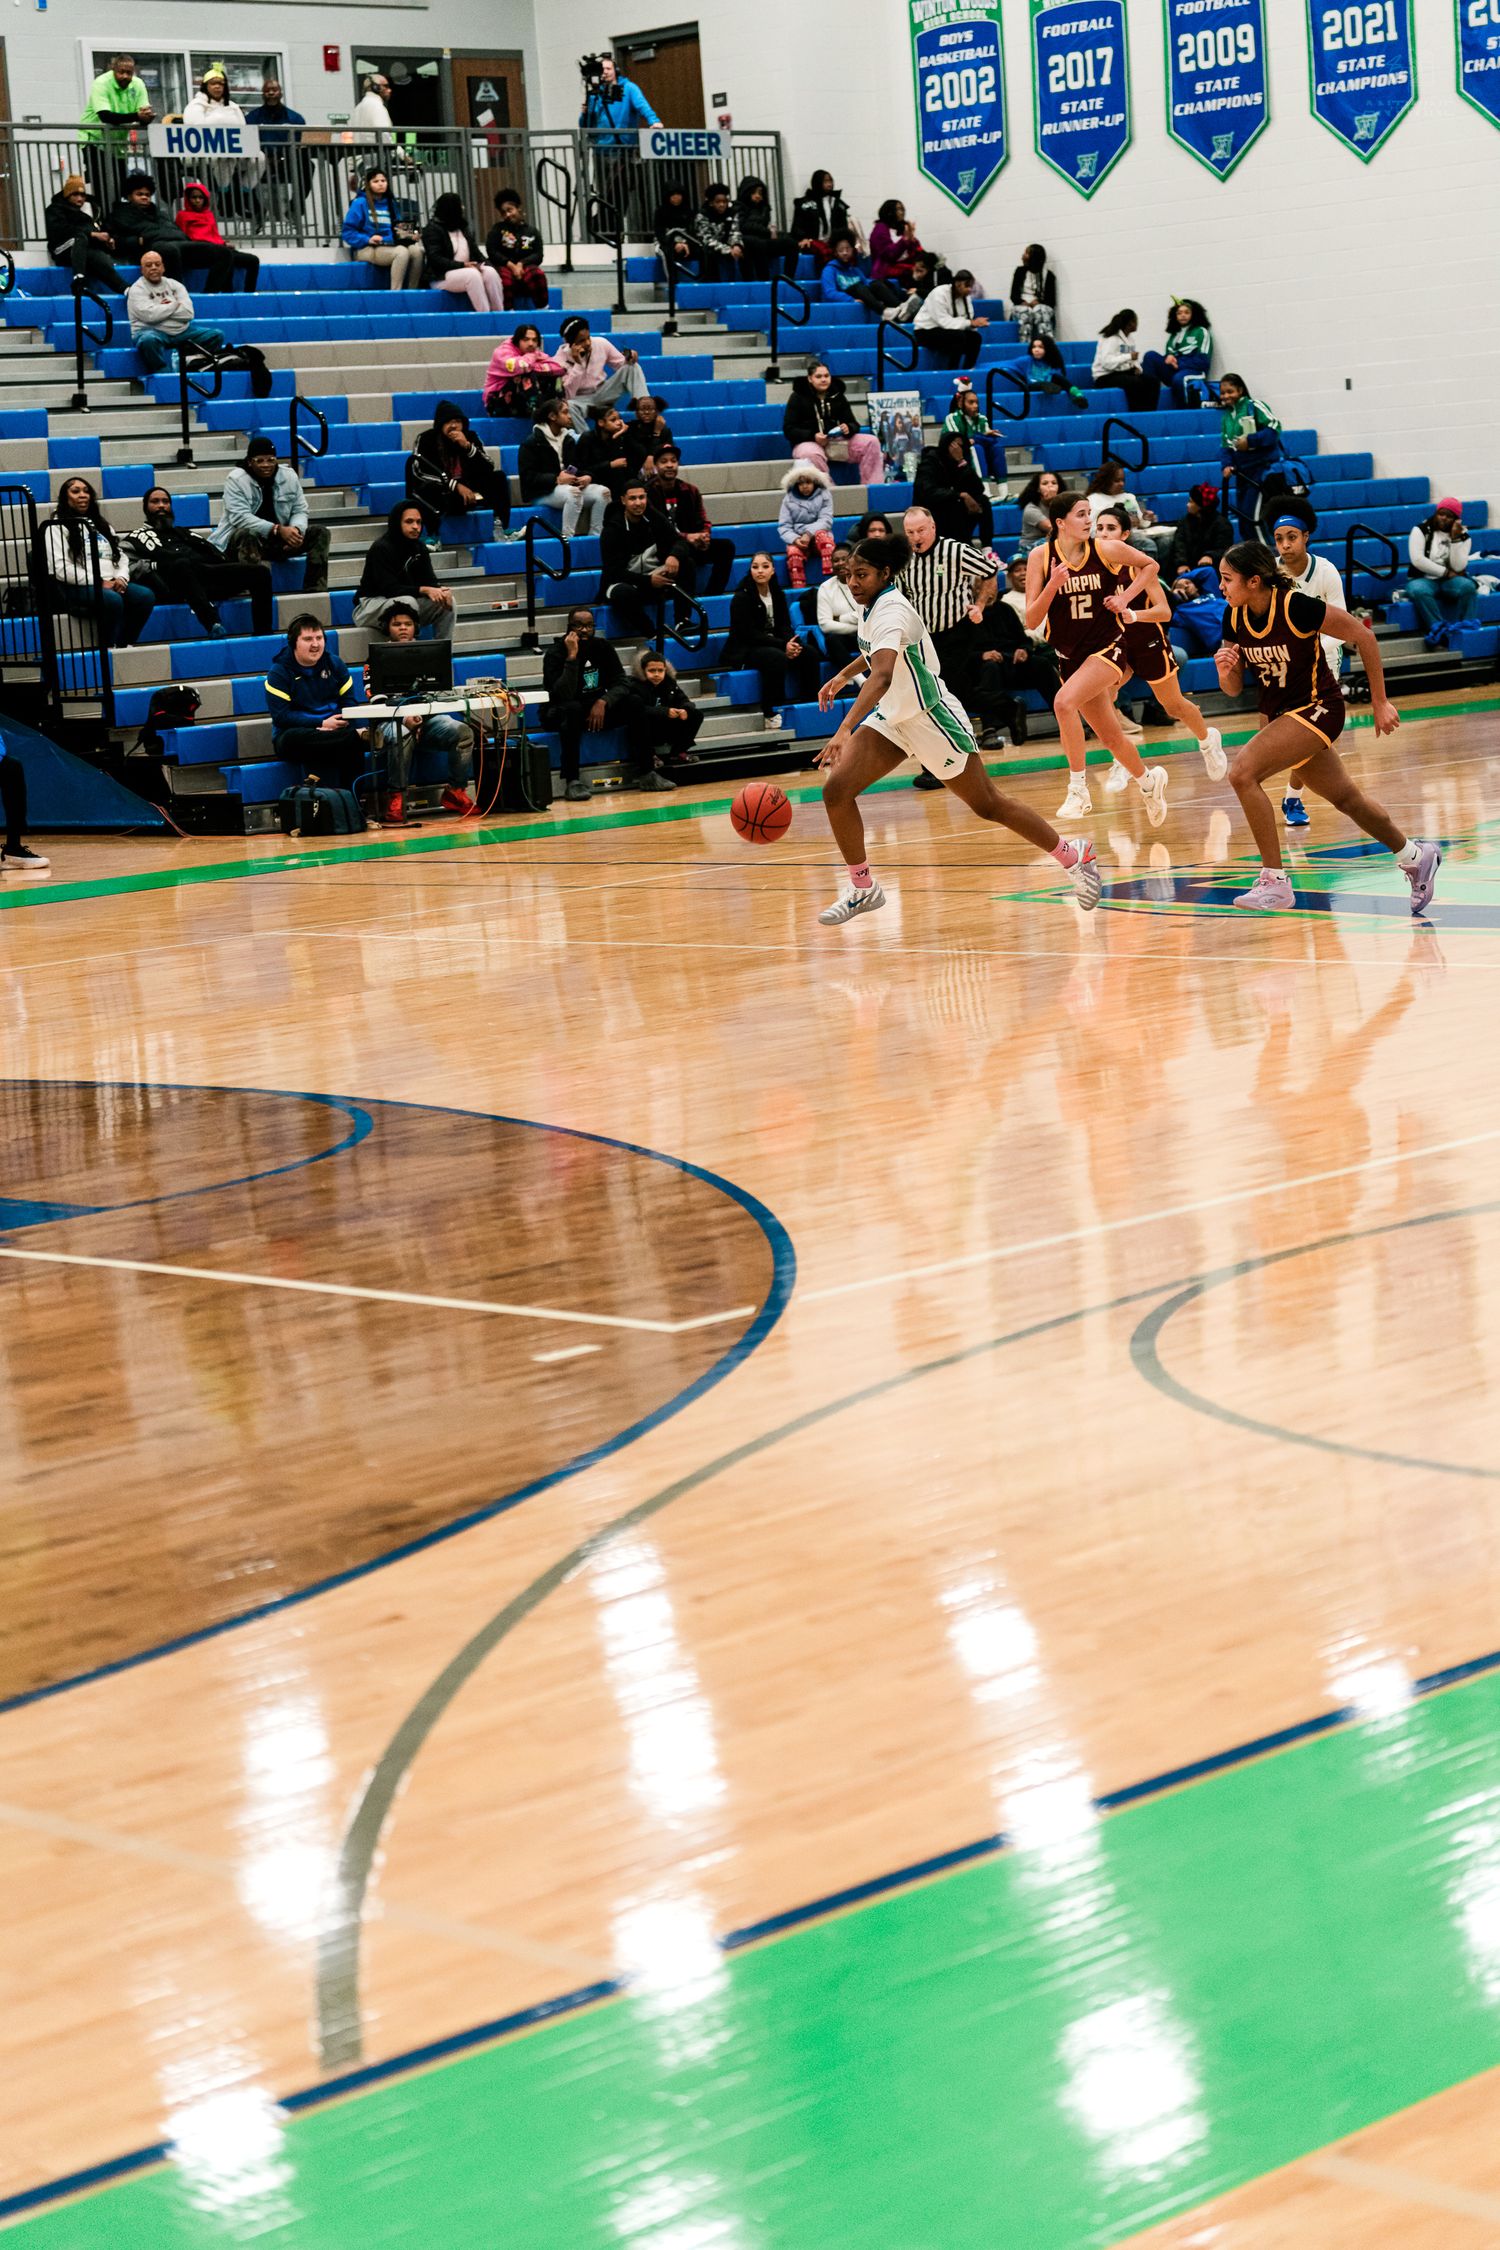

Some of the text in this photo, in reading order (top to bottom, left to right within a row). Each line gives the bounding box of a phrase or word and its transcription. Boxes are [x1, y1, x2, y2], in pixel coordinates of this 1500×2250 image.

[1042, 16, 1114, 38] FOOTBALL
[1322, 0, 1398, 51] 2021
[939, 30, 974, 47] BOYS
[1177, 23, 1256, 73] 2009
[1486, 36, 1500, 50] S
[919, 45, 997, 68] BASKETBALL
[1336, 54, 1386, 73] STATE
[1464, 55, 1500, 73] CHA
[1047, 46, 1114, 93] 2017
[925, 66, 996, 112] 2002
[1194, 76, 1241, 95] STATE
[1316, 71, 1409, 96] CHAMPIONS
[1060, 97, 1104, 115] STATE
[1173, 92, 1263, 116] CHAMPIONS
[941, 116, 982, 133] STATE
[1041, 113, 1125, 136] RUNNER-UP
[166, 127, 243, 154] HOME
[651, 132, 722, 156] CHEER
[924, 131, 1002, 153] RUNNER-UP
[1069, 594, 1093, 620] 12
[1240, 644, 1291, 664] URPIN
[1255, 661, 1288, 688] 24
